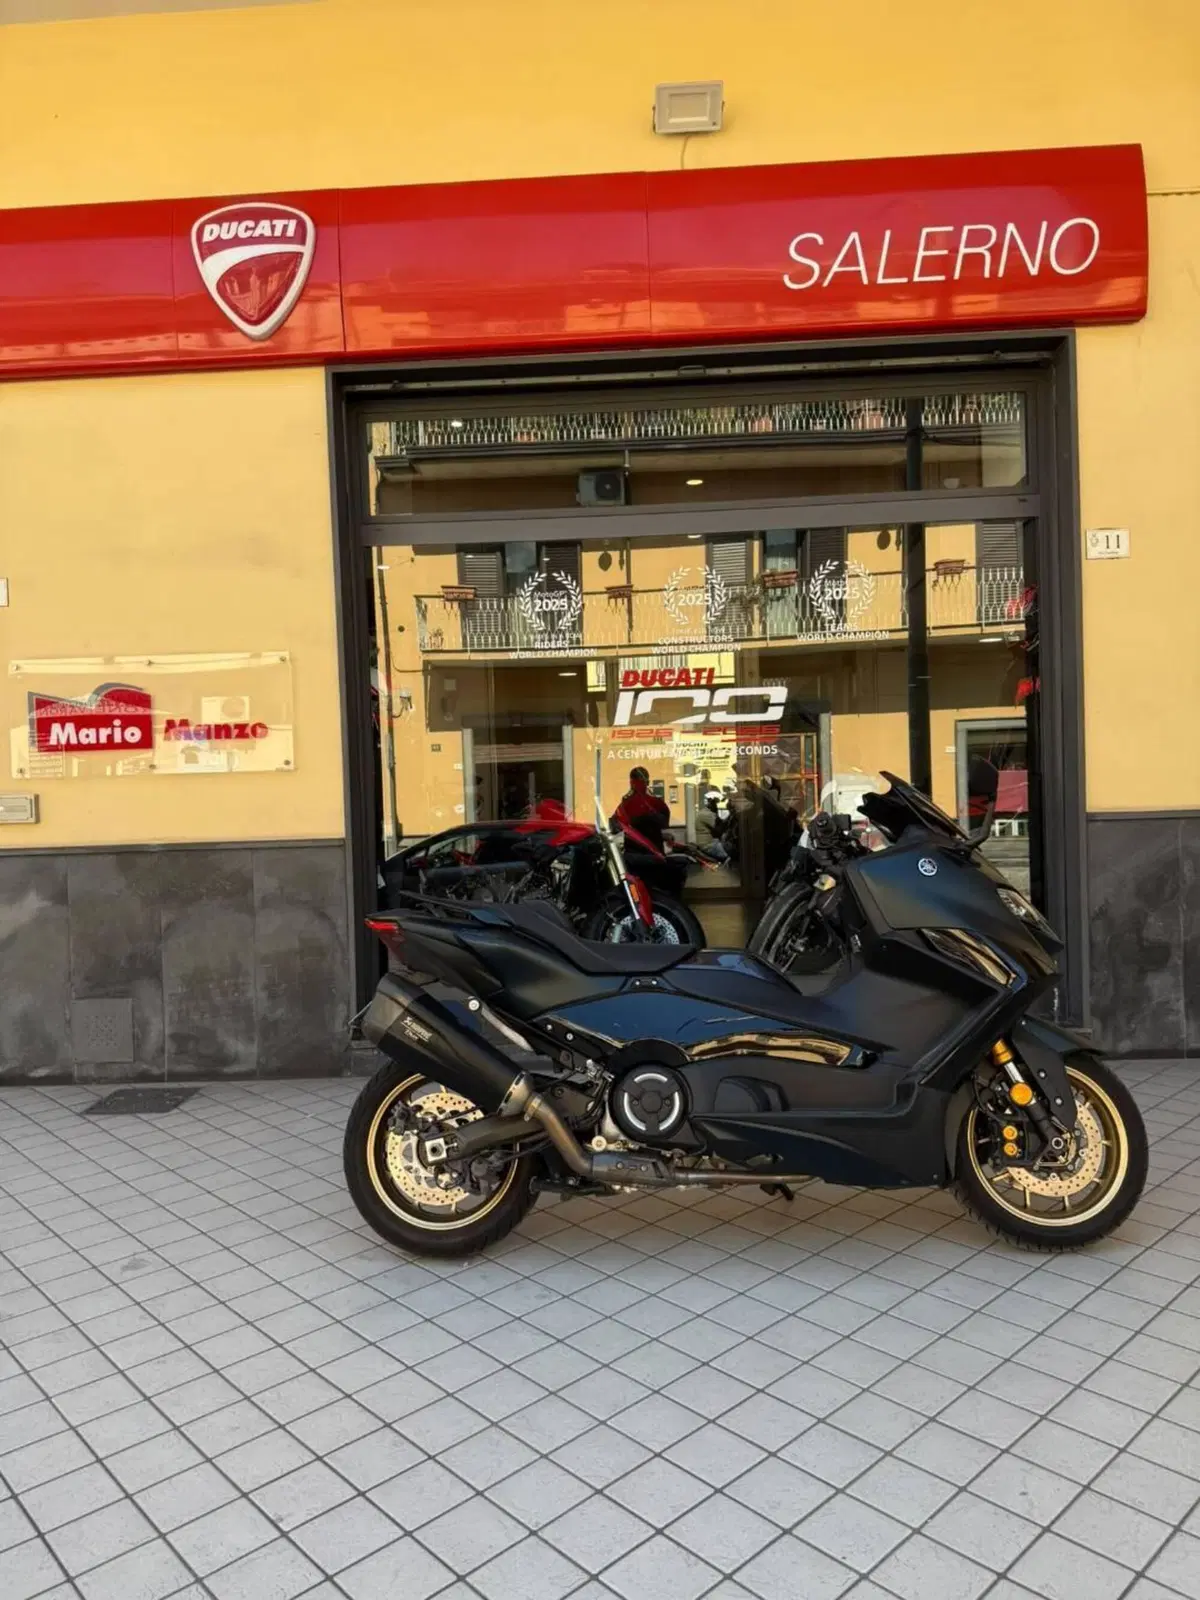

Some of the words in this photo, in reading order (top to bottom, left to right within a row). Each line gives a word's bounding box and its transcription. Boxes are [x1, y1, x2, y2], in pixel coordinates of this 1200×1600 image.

[202, 219, 297, 243] DUCATI
[783, 217, 1100, 290] SALERNO
[1105, 534, 1120, 549] 11
[678, 593, 713, 606] 2025
[824, 587, 860, 600] 2025
[534, 599, 568, 611] 2025
[658, 634, 734, 645] CONSTRUCTORS
[797, 632, 832, 641] WORLD
[835, 631, 890, 640] CHAMPION
[535, 640, 569, 649] RIDERS
[651, 646, 687, 654] WORLD
[689, 643, 741, 653] CHAMPION
[510, 651, 544, 659] WORLD
[547, 649, 597, 658] CHAMPION
[622, 667, 716, 687] DUCATI
[48, 719, 142, 746] Mario
[164, 718, 268, 740] Manzo
